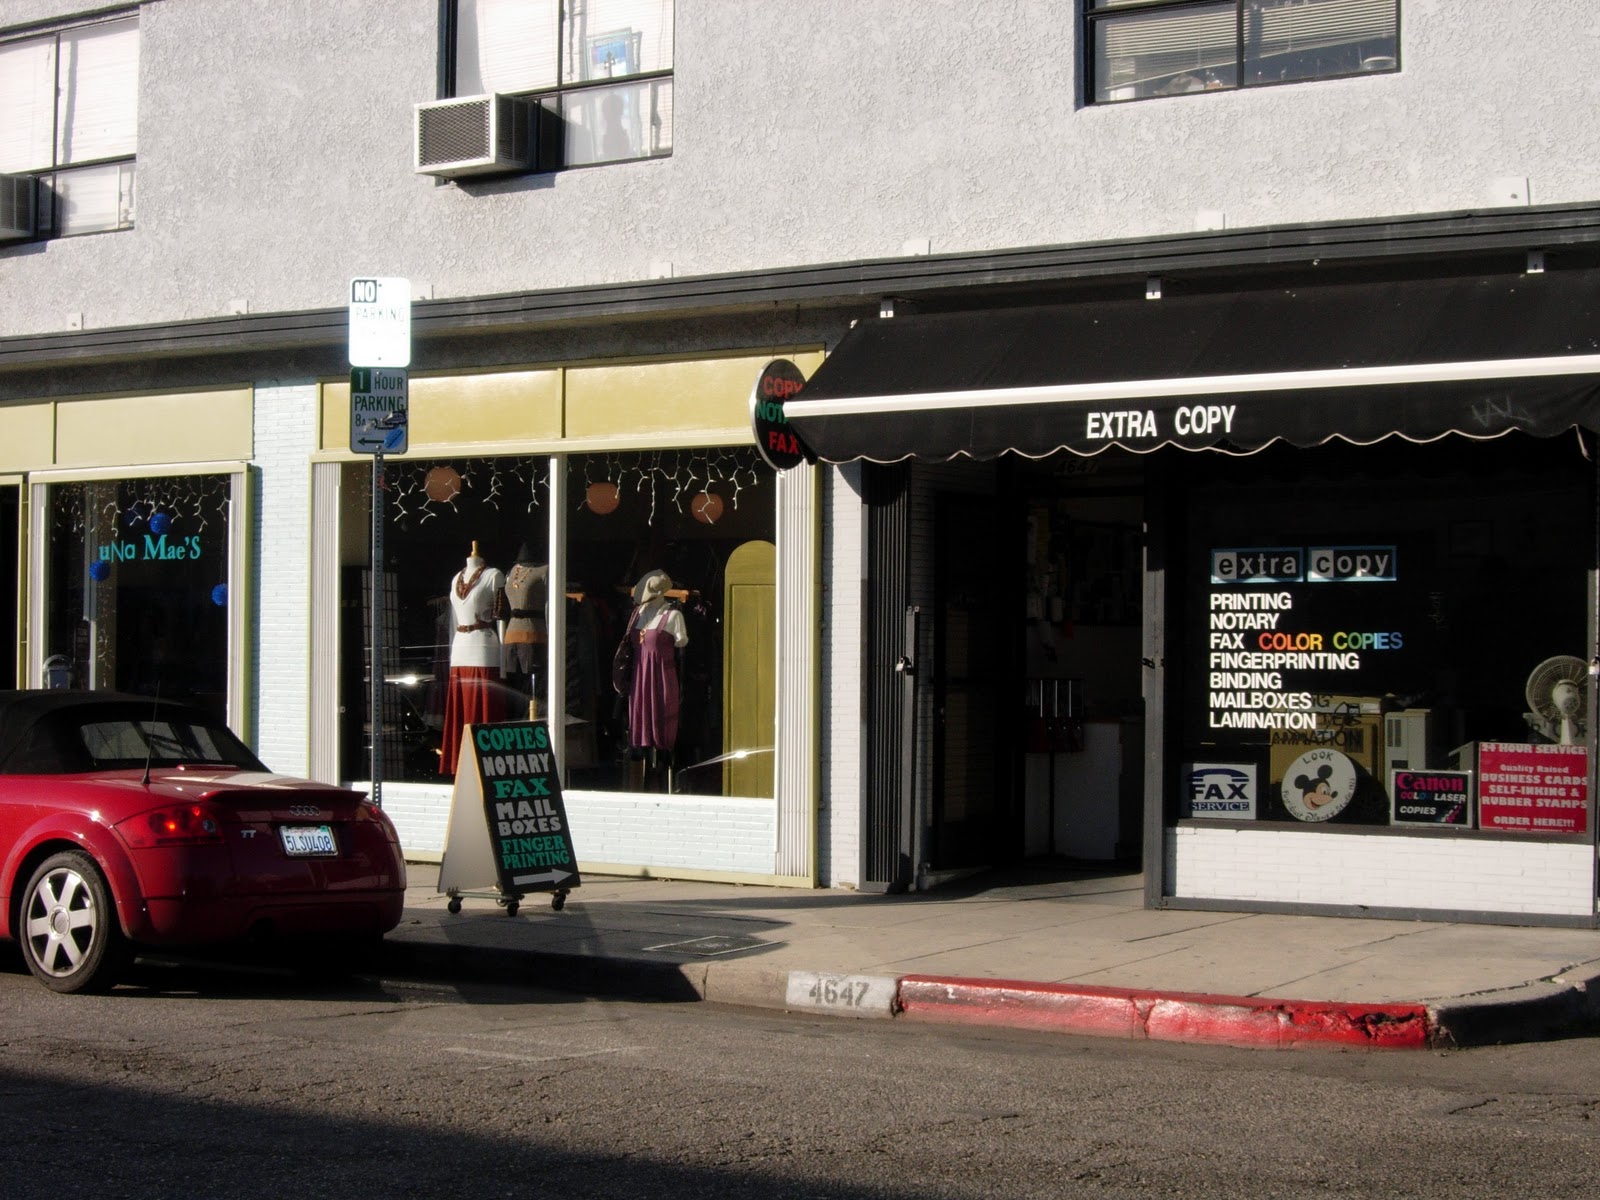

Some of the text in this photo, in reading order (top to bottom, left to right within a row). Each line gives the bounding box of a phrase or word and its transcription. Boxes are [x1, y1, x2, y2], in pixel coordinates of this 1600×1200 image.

[354, 281, 376, 302] NO
[359, 371, 404, 391] 1 HOUR
[764, 376, 803, 398] COPY
[354, 395, 405, 412] PARKING
[1086, 404, 1237, 439] EXTRA COPY
[769, 432, 799, 455] FAX
[1218, 552, 1390, 578] extra copy
[1210, 592, 1293, 611] PRINTING
[1210, 612, 1280, 630] NOTARY
[1210, 631, 1404, 651] FAX COLOR COPIES
[1210, 652, 1360, 671] FINGERPRINTING
[1210, 672, 1283, 690] BINDING
[1209, 692, 1313, 711] MAILBOXES
[1209, 712, 1318, 731] LAMINATION
[476, 726, 548, 752] COPIES
[482, 752, 550, 777] NOTARY
[1302, 750, 1334, 765] LOOK
[1500, 764, 1570, 774] Quality Raised
[493, 777, 551, 799] FAX
[1396, 773, 1465, 793] Canon
[1481, 773, 1588, 786] BUSINESS CARDS
[1190, 783, 1249, 800] FAX
[1400, 791, 1467, 804] COLO LASER
[1488, 784, 1580, 798] SELF-INKING &
[495, 798, 557, 821] MAIL
[1192, 802, 1249, 811] SERVICE
[1399, 806, 1437, 815] COPIES
[1481, 796, 1588, 809] RUBBER STAMPS
[497, 816, 562, 837] BOXES
[1493, 816, 1576, 828] ORDER HERE!!!
[241, 829, 257, 838] TT
[501, 835, 567, 855] FINGER
[502, 851, 570, 870] PRINTING
[808, 977, 870, 1007] 4647
